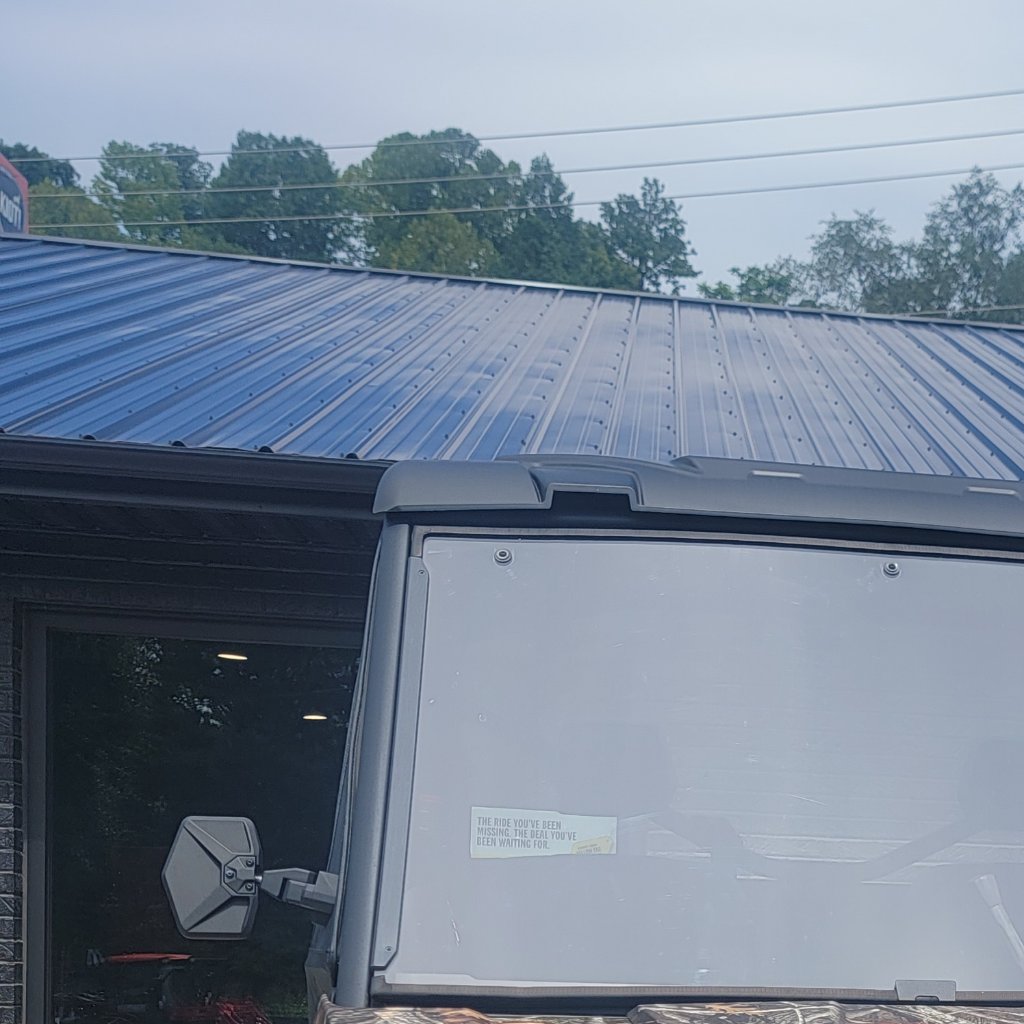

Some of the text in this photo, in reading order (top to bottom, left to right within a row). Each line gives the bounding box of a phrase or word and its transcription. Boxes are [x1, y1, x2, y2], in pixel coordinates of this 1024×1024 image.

[477, 816, 561, 830] THE RIDE YOU'VE BEEN
[477, 827, 577, 841] MISSING. THE DEAL YOU'VE
[477, 836, 550, 850] BEEN WAITING FOR.
